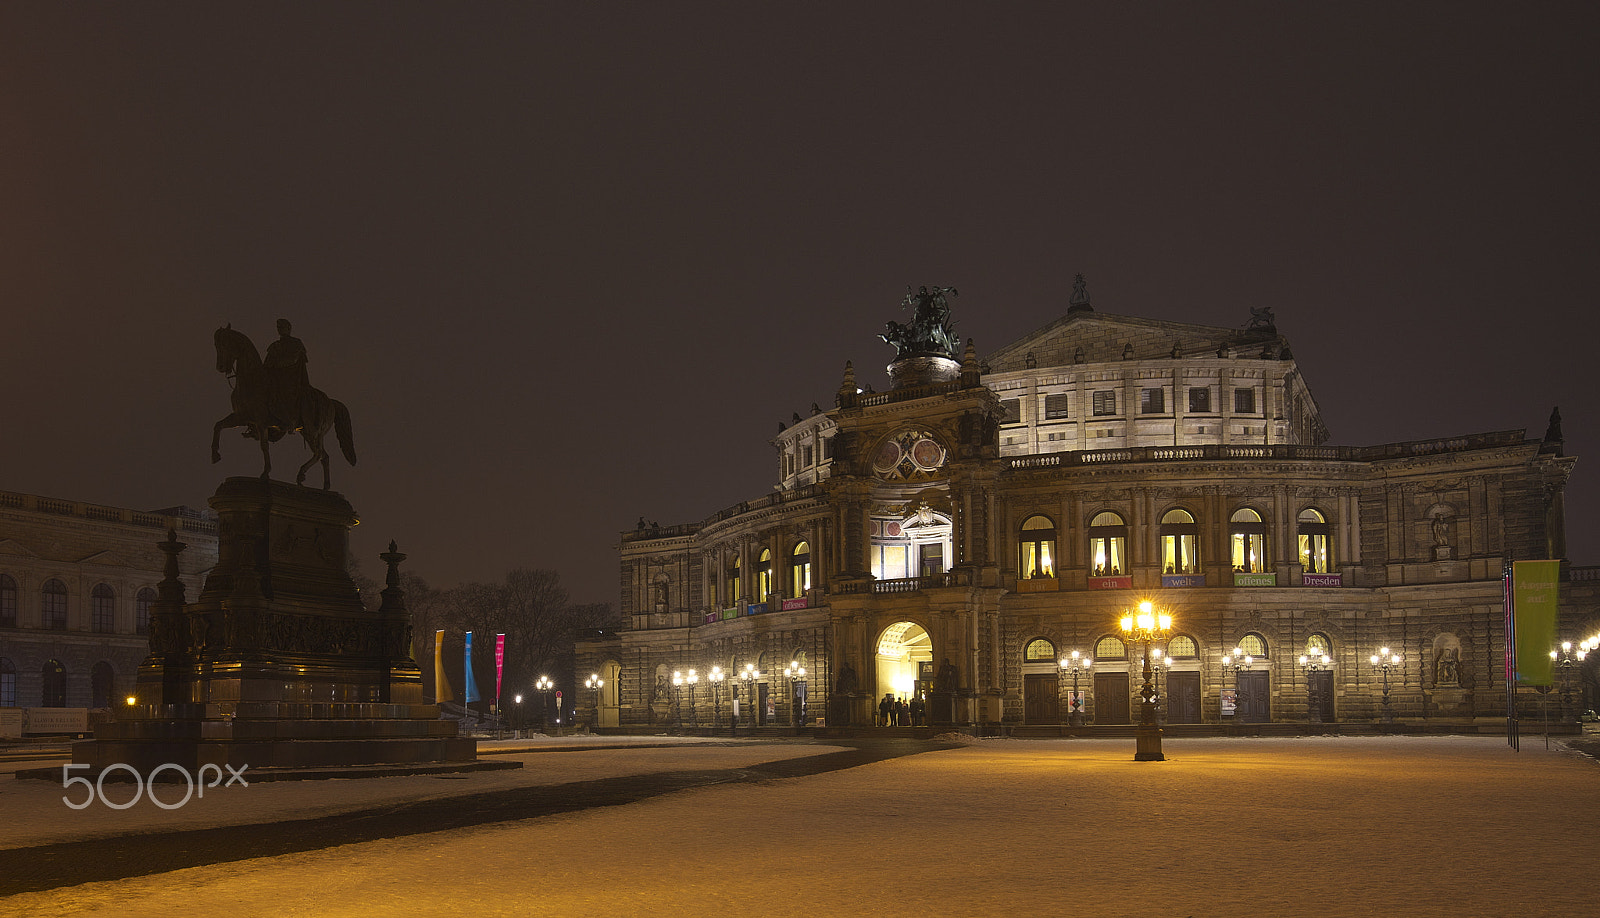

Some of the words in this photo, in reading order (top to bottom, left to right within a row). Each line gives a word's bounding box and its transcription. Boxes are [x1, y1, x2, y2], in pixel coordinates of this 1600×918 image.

[1102, 579, 1118, 589] ein
[1171, 576, 1195, 586] welt-
[1238, 576, 1272, 586] offenes
[1304, 576, 1341, 586] Dresden
